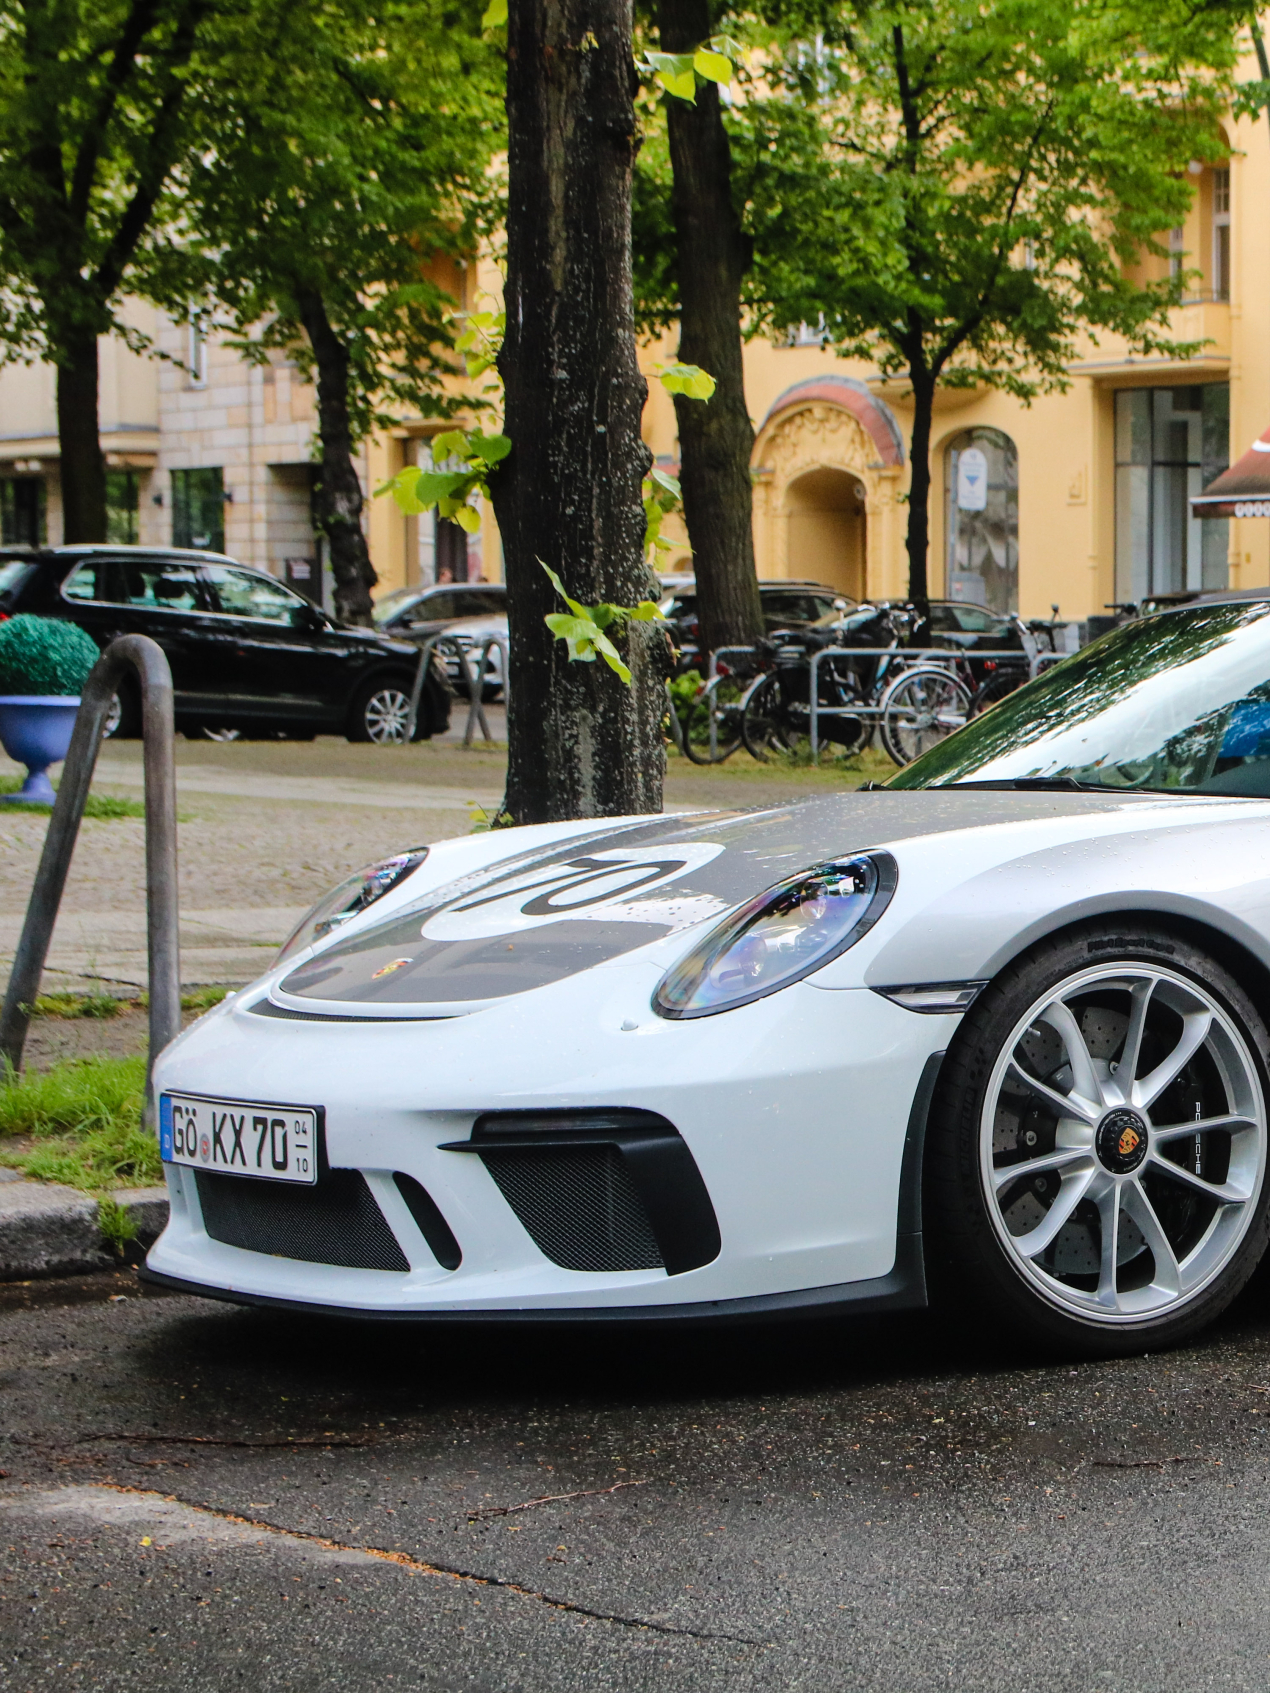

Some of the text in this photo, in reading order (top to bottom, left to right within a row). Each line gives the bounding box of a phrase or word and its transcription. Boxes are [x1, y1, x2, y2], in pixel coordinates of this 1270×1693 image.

[451, 857, 689, 916] 70
[172, 1105, 198, 1158] GÖ
[294, 1120, 308, 1135] 04
[296, 1157, 309, 1173] 10
